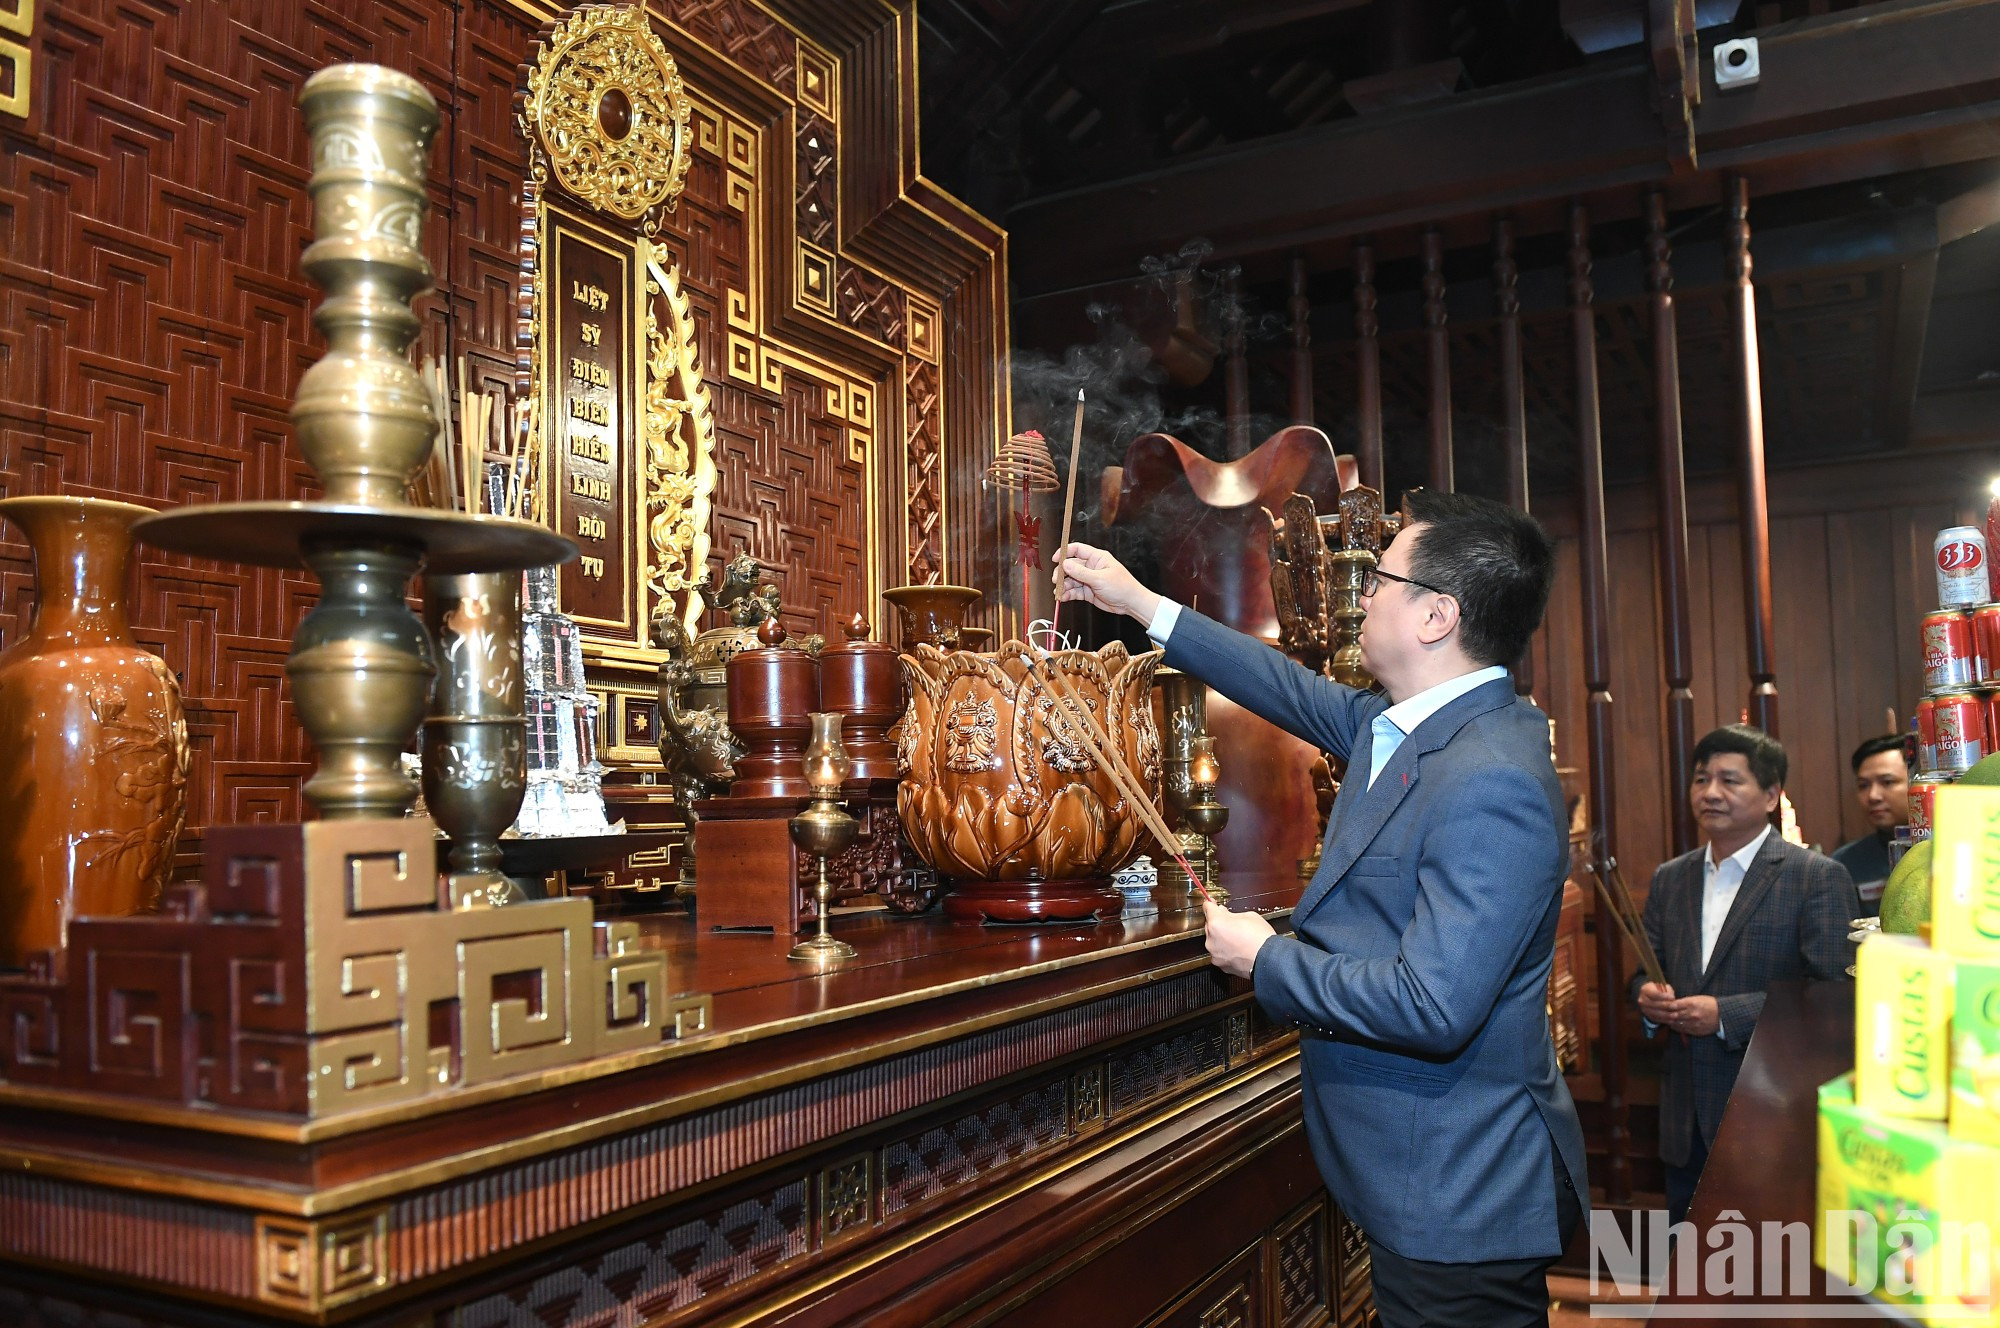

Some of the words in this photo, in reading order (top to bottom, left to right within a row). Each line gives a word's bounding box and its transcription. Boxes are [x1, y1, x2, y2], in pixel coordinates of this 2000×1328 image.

[573, 280, 609, 311] LIỆT
[572, 357, 610, 388] ĐIỆN
[572, 474, 611, 502] LINH
[578, 513, 606, 543] HỘI
[580, 555, 604, 582] TỤ
[1942, 539, 1974, 569] 333
[1936, 739, 1968, 751] AIGON
[1912, 827, 1932, 837] GON
